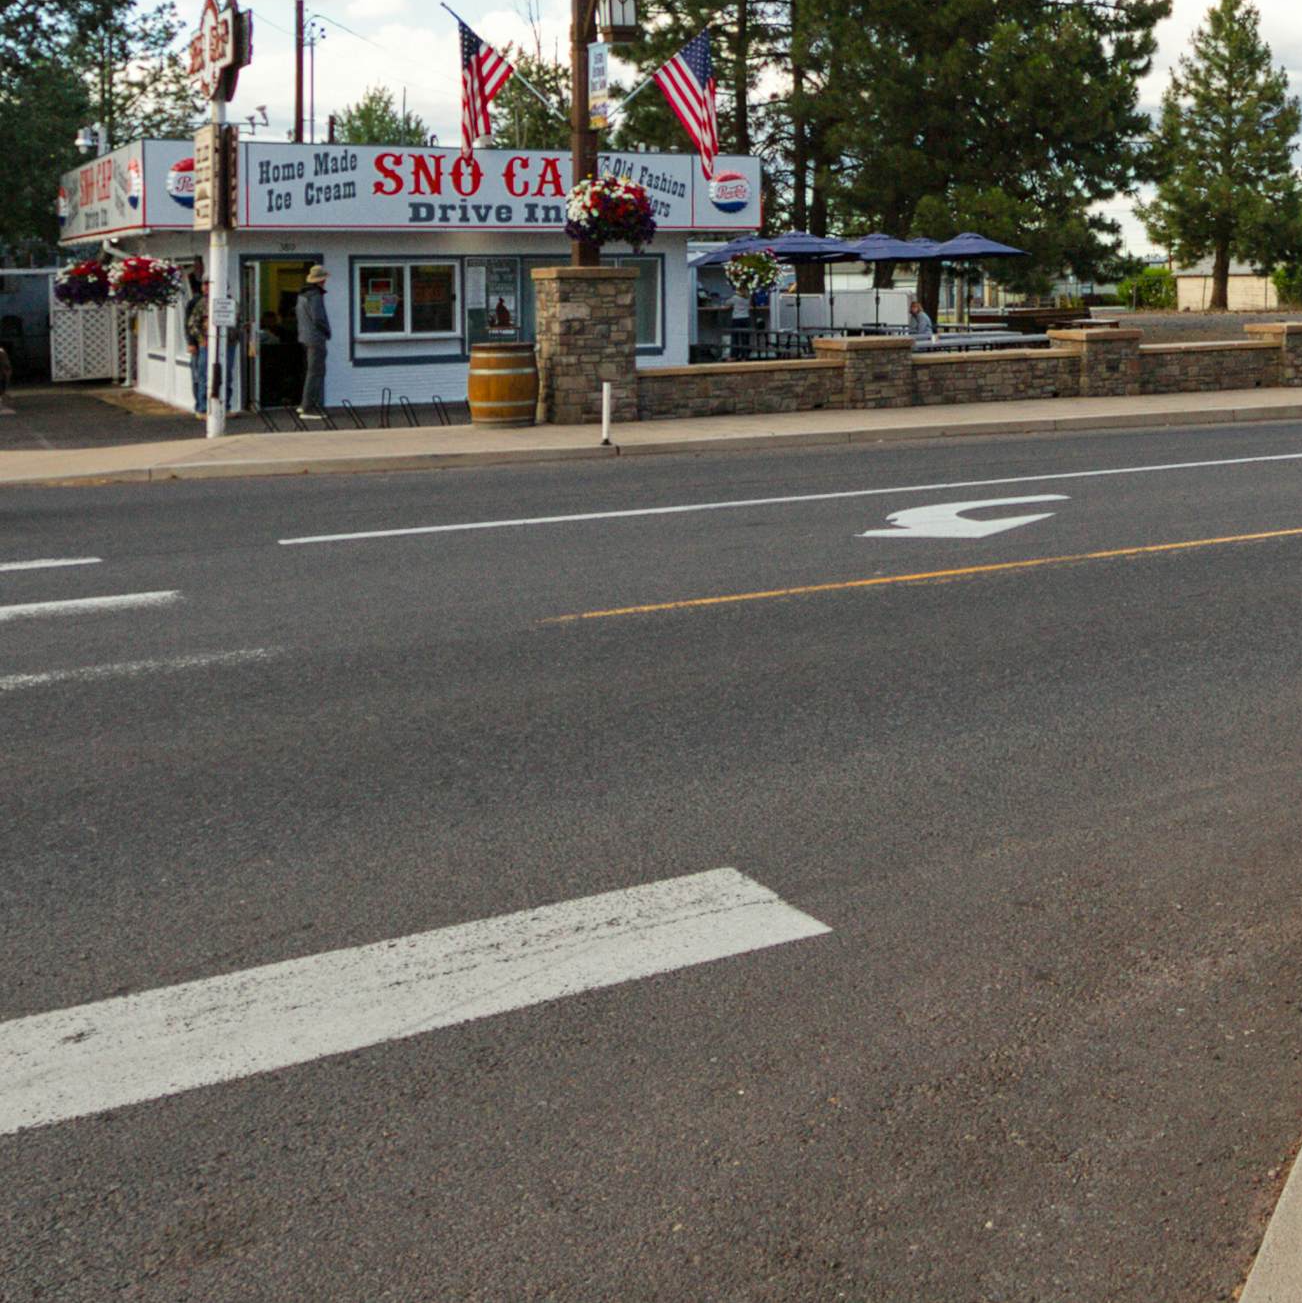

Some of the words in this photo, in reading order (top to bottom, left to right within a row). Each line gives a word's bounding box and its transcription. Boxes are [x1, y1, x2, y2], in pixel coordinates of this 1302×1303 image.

[258, 160, 304, 184] Home
[313, 150, 357, 176] Made
[372, 153, 484, 197] SNO
[502, 156, 566, 197] CA
[613, 158, 634, 179] Old
[640, 165, 686, 197] Fashion
[266, 189, 291, 212] Ice
[304, 180, 356, 206] Cream
[409, 199, 513, 223] Drive
[525, 203, 563, 223] In
